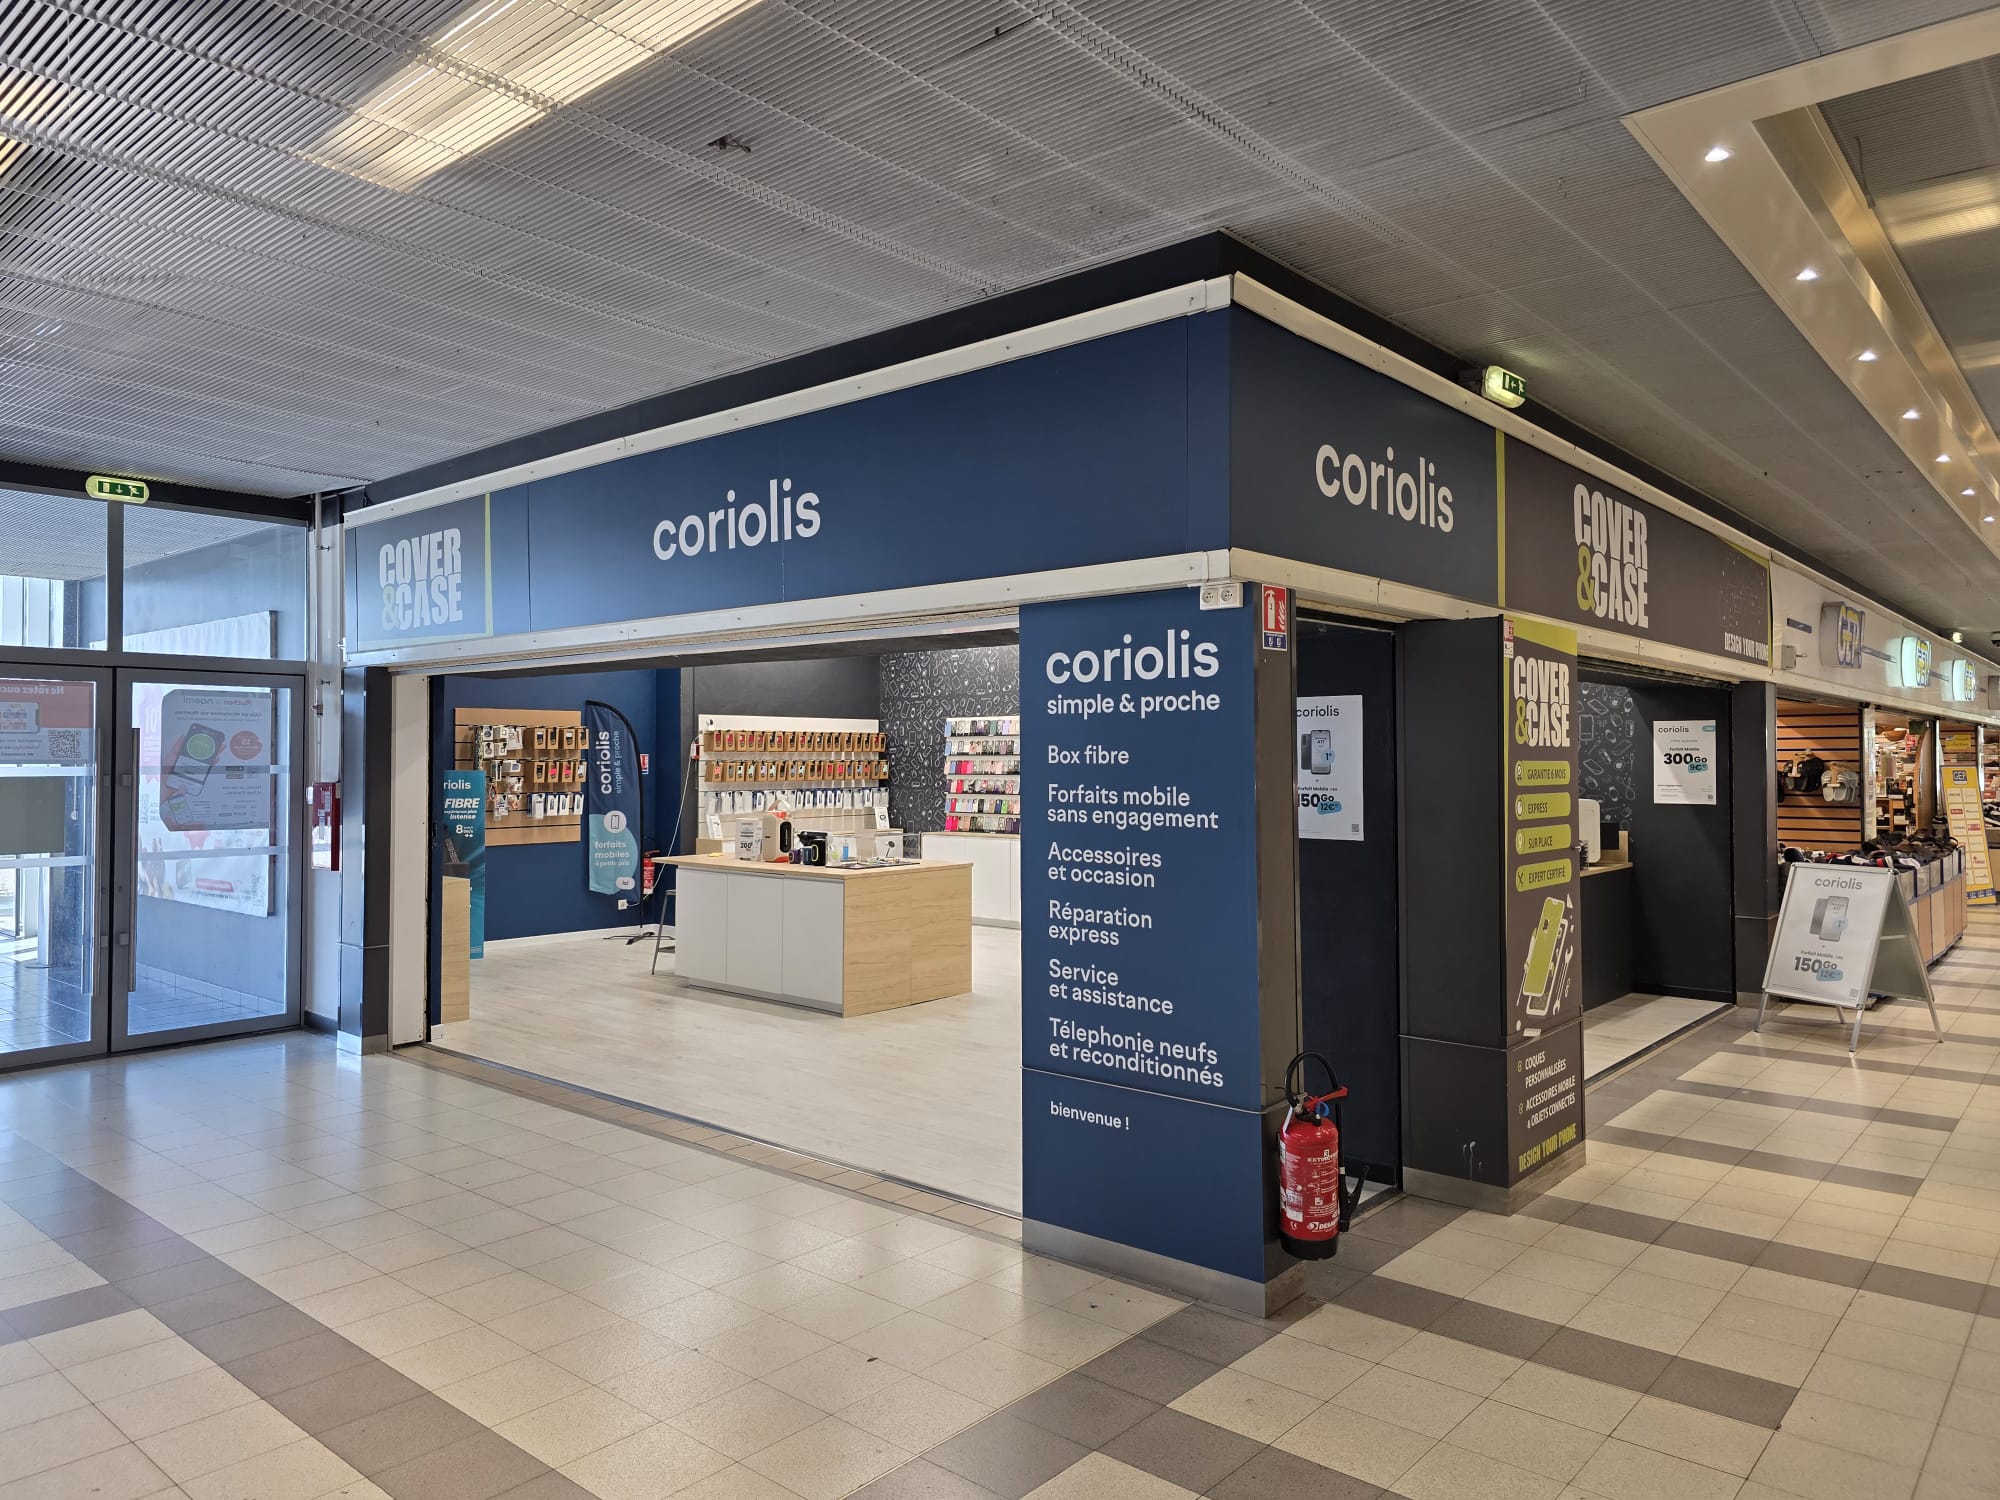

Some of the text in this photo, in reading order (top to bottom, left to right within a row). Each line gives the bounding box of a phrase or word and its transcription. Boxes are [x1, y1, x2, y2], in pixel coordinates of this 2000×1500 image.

[1315, 444, 1454, 533] coriolis
[653, 478, 821, 561] coriolis
[1573, 483, 1648, 570] COVER
[379, 528, 462, 588] COVER
[1046, 629, 1220, 684] coriolis
[1724, 631, 1742, 655] DESIGN
[1742, 637, 1755, 658] YOUR
[1513, 655, 1570, 706] COVER
[1047, 690, 1221, 721] simple & proche
[1297, 704, 1340, 718] coriolis
[1658, 725, 1690, 734] coriolis
[613, 730, 623, 760] proche
[1048, 745, 1130, 765] Box fibre
[596, 731, 612, 795] coriolis
[1664, 753, 1694, 765] 300
[614, 771, 623, 794] simple
[1527, 769, 1551, 780] GARANTIE
[1555, 768, 1567, 779] MOIS
[444, 797, 481, 809] FIBRE
[1048, 783, 1191, 807] Forfaits mobile
[1321, 794, 1335, 802] Go
[1047, 808, 1219, 832] sans engagement
[1527, 802, 1548, 814] EXPRESS
[455, 824, 463, 834] 8
[594, 840, 627, 849] forfaits
[1528, 835, 1553, 849] SUR PLACE
[594, 851, 631, 859] mobiles
[1048, 842, 1162, 868] Accessoires
[1048, 866, 1156, 888] et occasion
[1528, 865, 1566, 884] EXPERT CERTIFIÉ
[1814, 877, 1864, 890] coriolis
[1048, 899, 1153, 929] Réparation
[1048, 923, 1120, 946] express
[1048, 959, 1119, 987] Service
[1794, 956, 1838, 973] 150 Go
[1049, 982, 1174, 1015] et assistance
[1049, 1017, 1218, 1065] Télephonie neufs
[1049, 1041, 1224, 1088] et reconditionnés
[1524, 1051, 1546, 1071] COQUES
[1525, 1058, 1567, 1089] PERSONNALISÉES
[1526, 1075, 1576, 1112] ACCESSOIRES MOBILE
[1050, 1101, 1129, 1131] bienvenue !
[1531, 1109, 1549, 1127] OBJETS
[1548, 1093, 1576, 1117] CONNECTÉS
[1519, 1122, 1577, 1173] DESIGN YOUR PHONE
